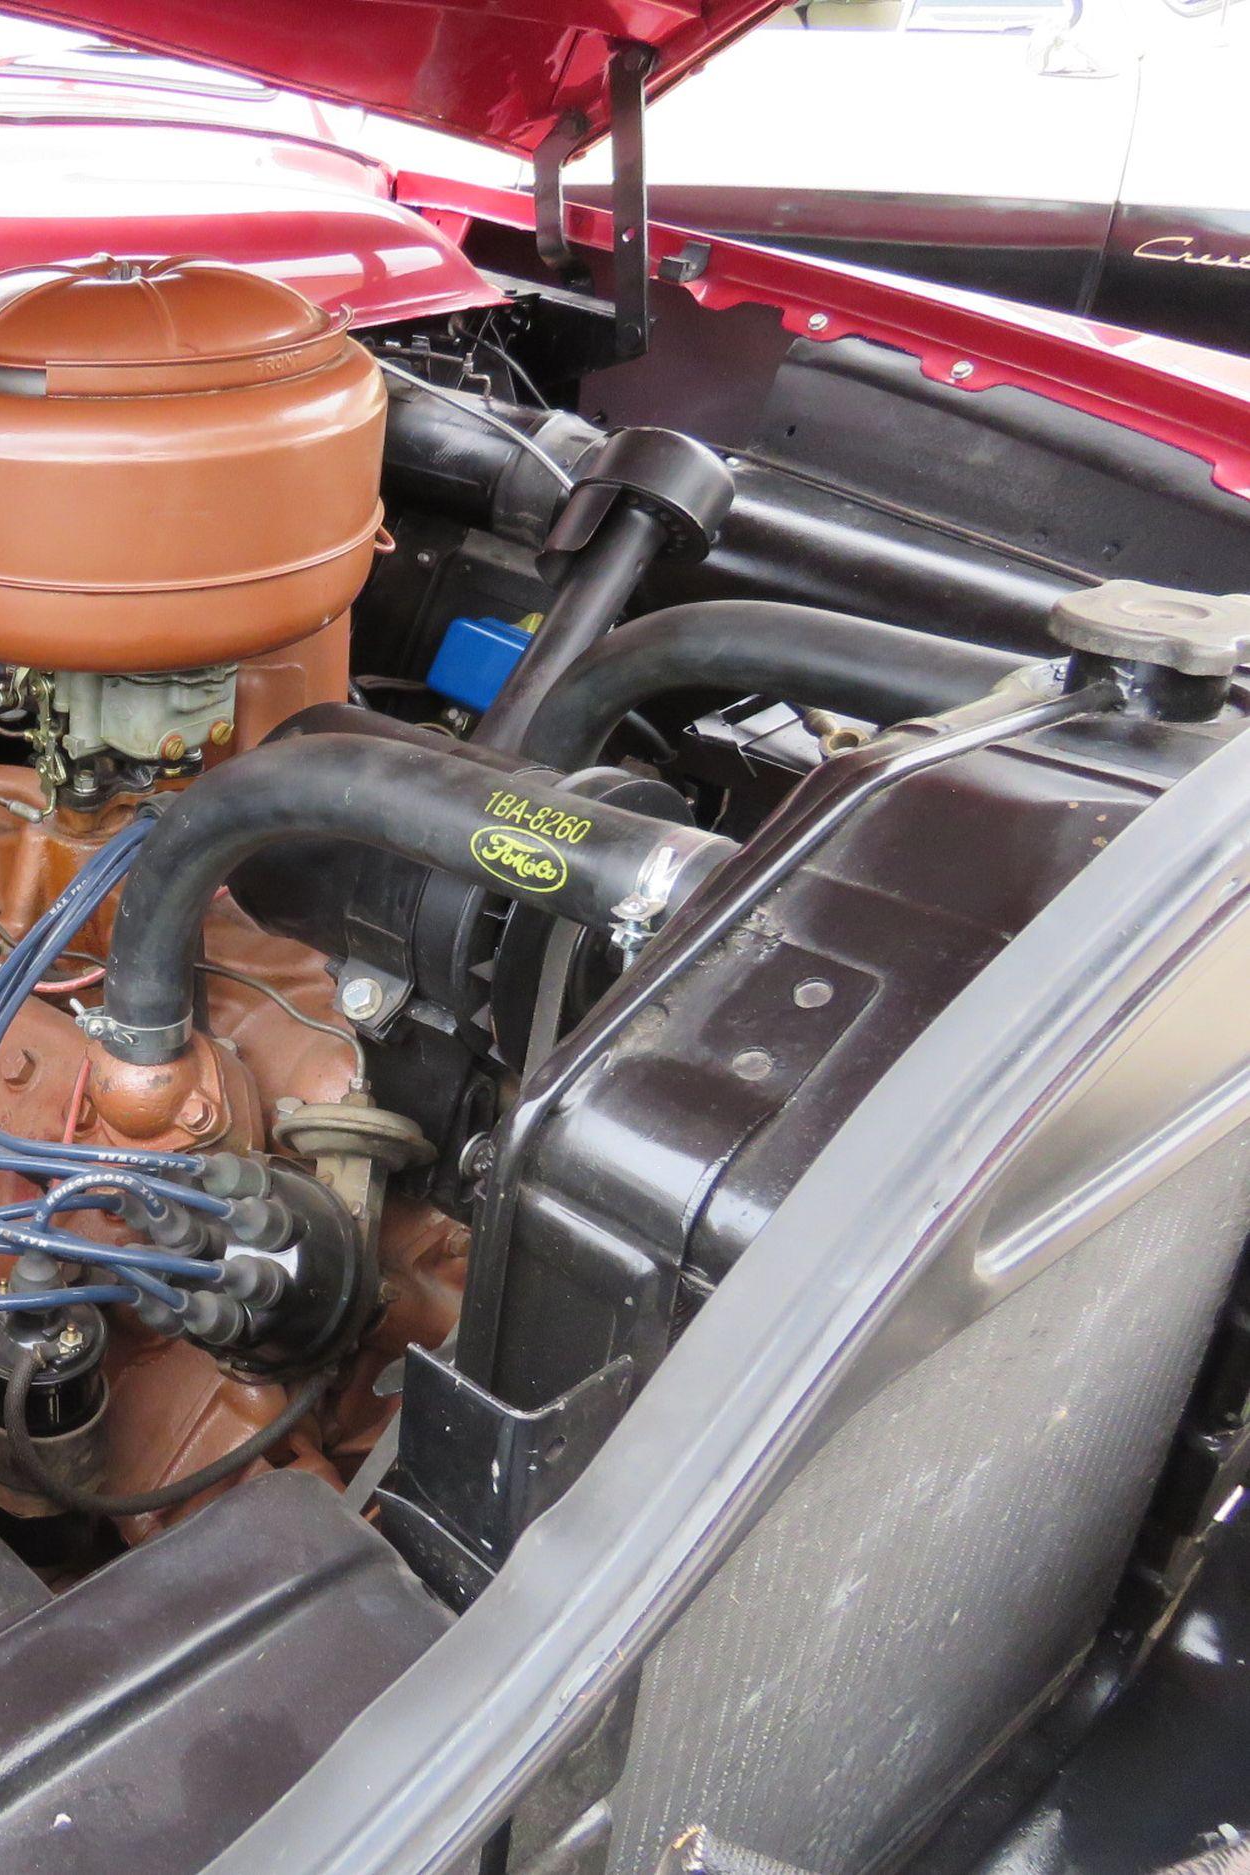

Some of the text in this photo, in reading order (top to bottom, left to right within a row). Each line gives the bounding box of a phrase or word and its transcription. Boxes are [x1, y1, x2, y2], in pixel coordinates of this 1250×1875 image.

[254, 349, 303, 375] FRONT
[483, 789, 593, 845] 1BA-8260
[48, 896, 70, 916] MAX
[97, 1152, 187, 1170] MAX POWER
[45, 1172, 161, 1209] MAX PROTECTION
[18, 1234, 49, 1248] MAX
